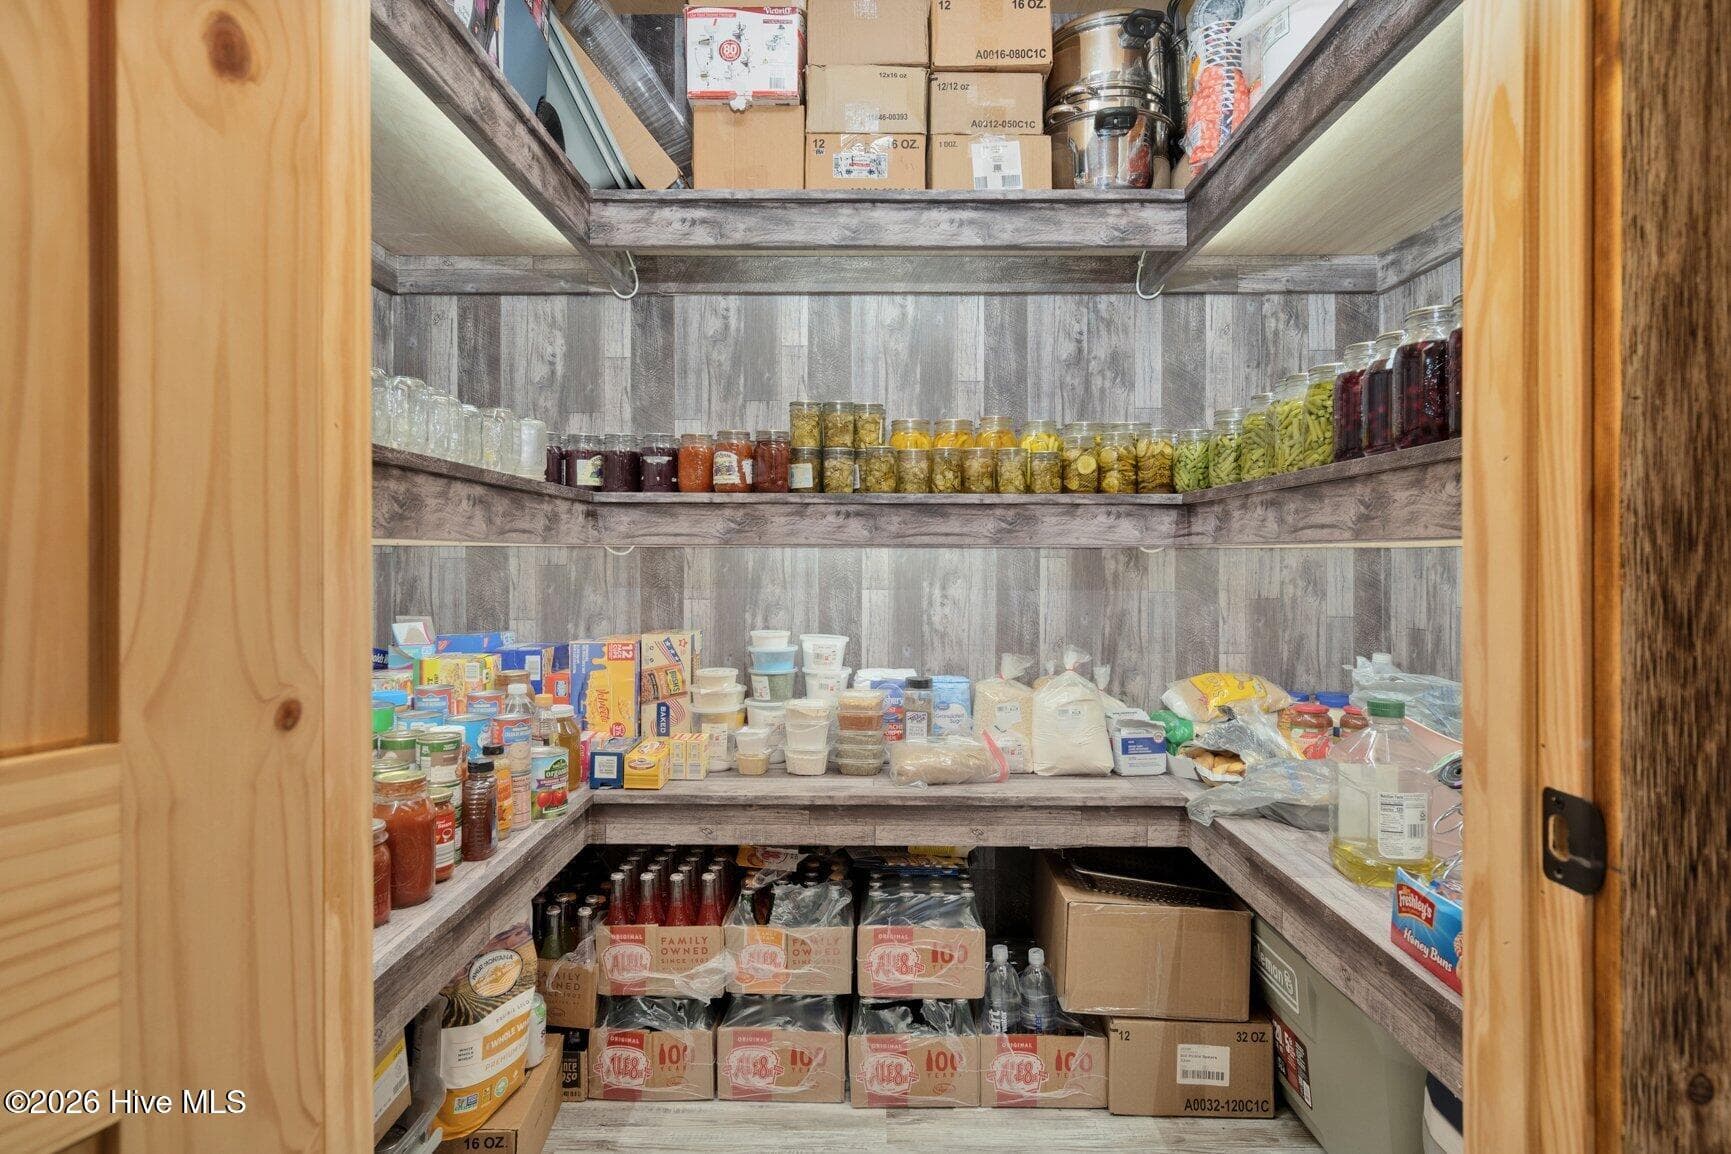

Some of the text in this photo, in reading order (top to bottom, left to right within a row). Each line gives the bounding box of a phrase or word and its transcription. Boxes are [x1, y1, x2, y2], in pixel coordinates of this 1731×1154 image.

[939, 0, 950, 10] 12
[1012, 0, 1046, 9] 16 OZ.
[723, 44, 738, 54] 80
[976, 49, 1046, 59] A0016-080C1C
[813, 139, 825, 148] 12
[901, 140, 919, 149] OZ.
[1399, 890, 1432, 920] Freshley's
[661, 936, 708, 945] FAMILY
[661, 947, 708, 955] OWNED
[793, 948, 840, 956] OWED
[1404, 927, 1453, 972] Honey Buns
[989, 1009, 1000, 1032] art
[491, 1027, 516, 1048] WHOLE
[1118, 1031, 1130, 1041] 12
[1236, 1032, 1269, 1042] 32 OZ.
[1184, 1098, 1269, 1112] A0032-120C1C
[464, 1137, 508, 1150] 16 OZ.
